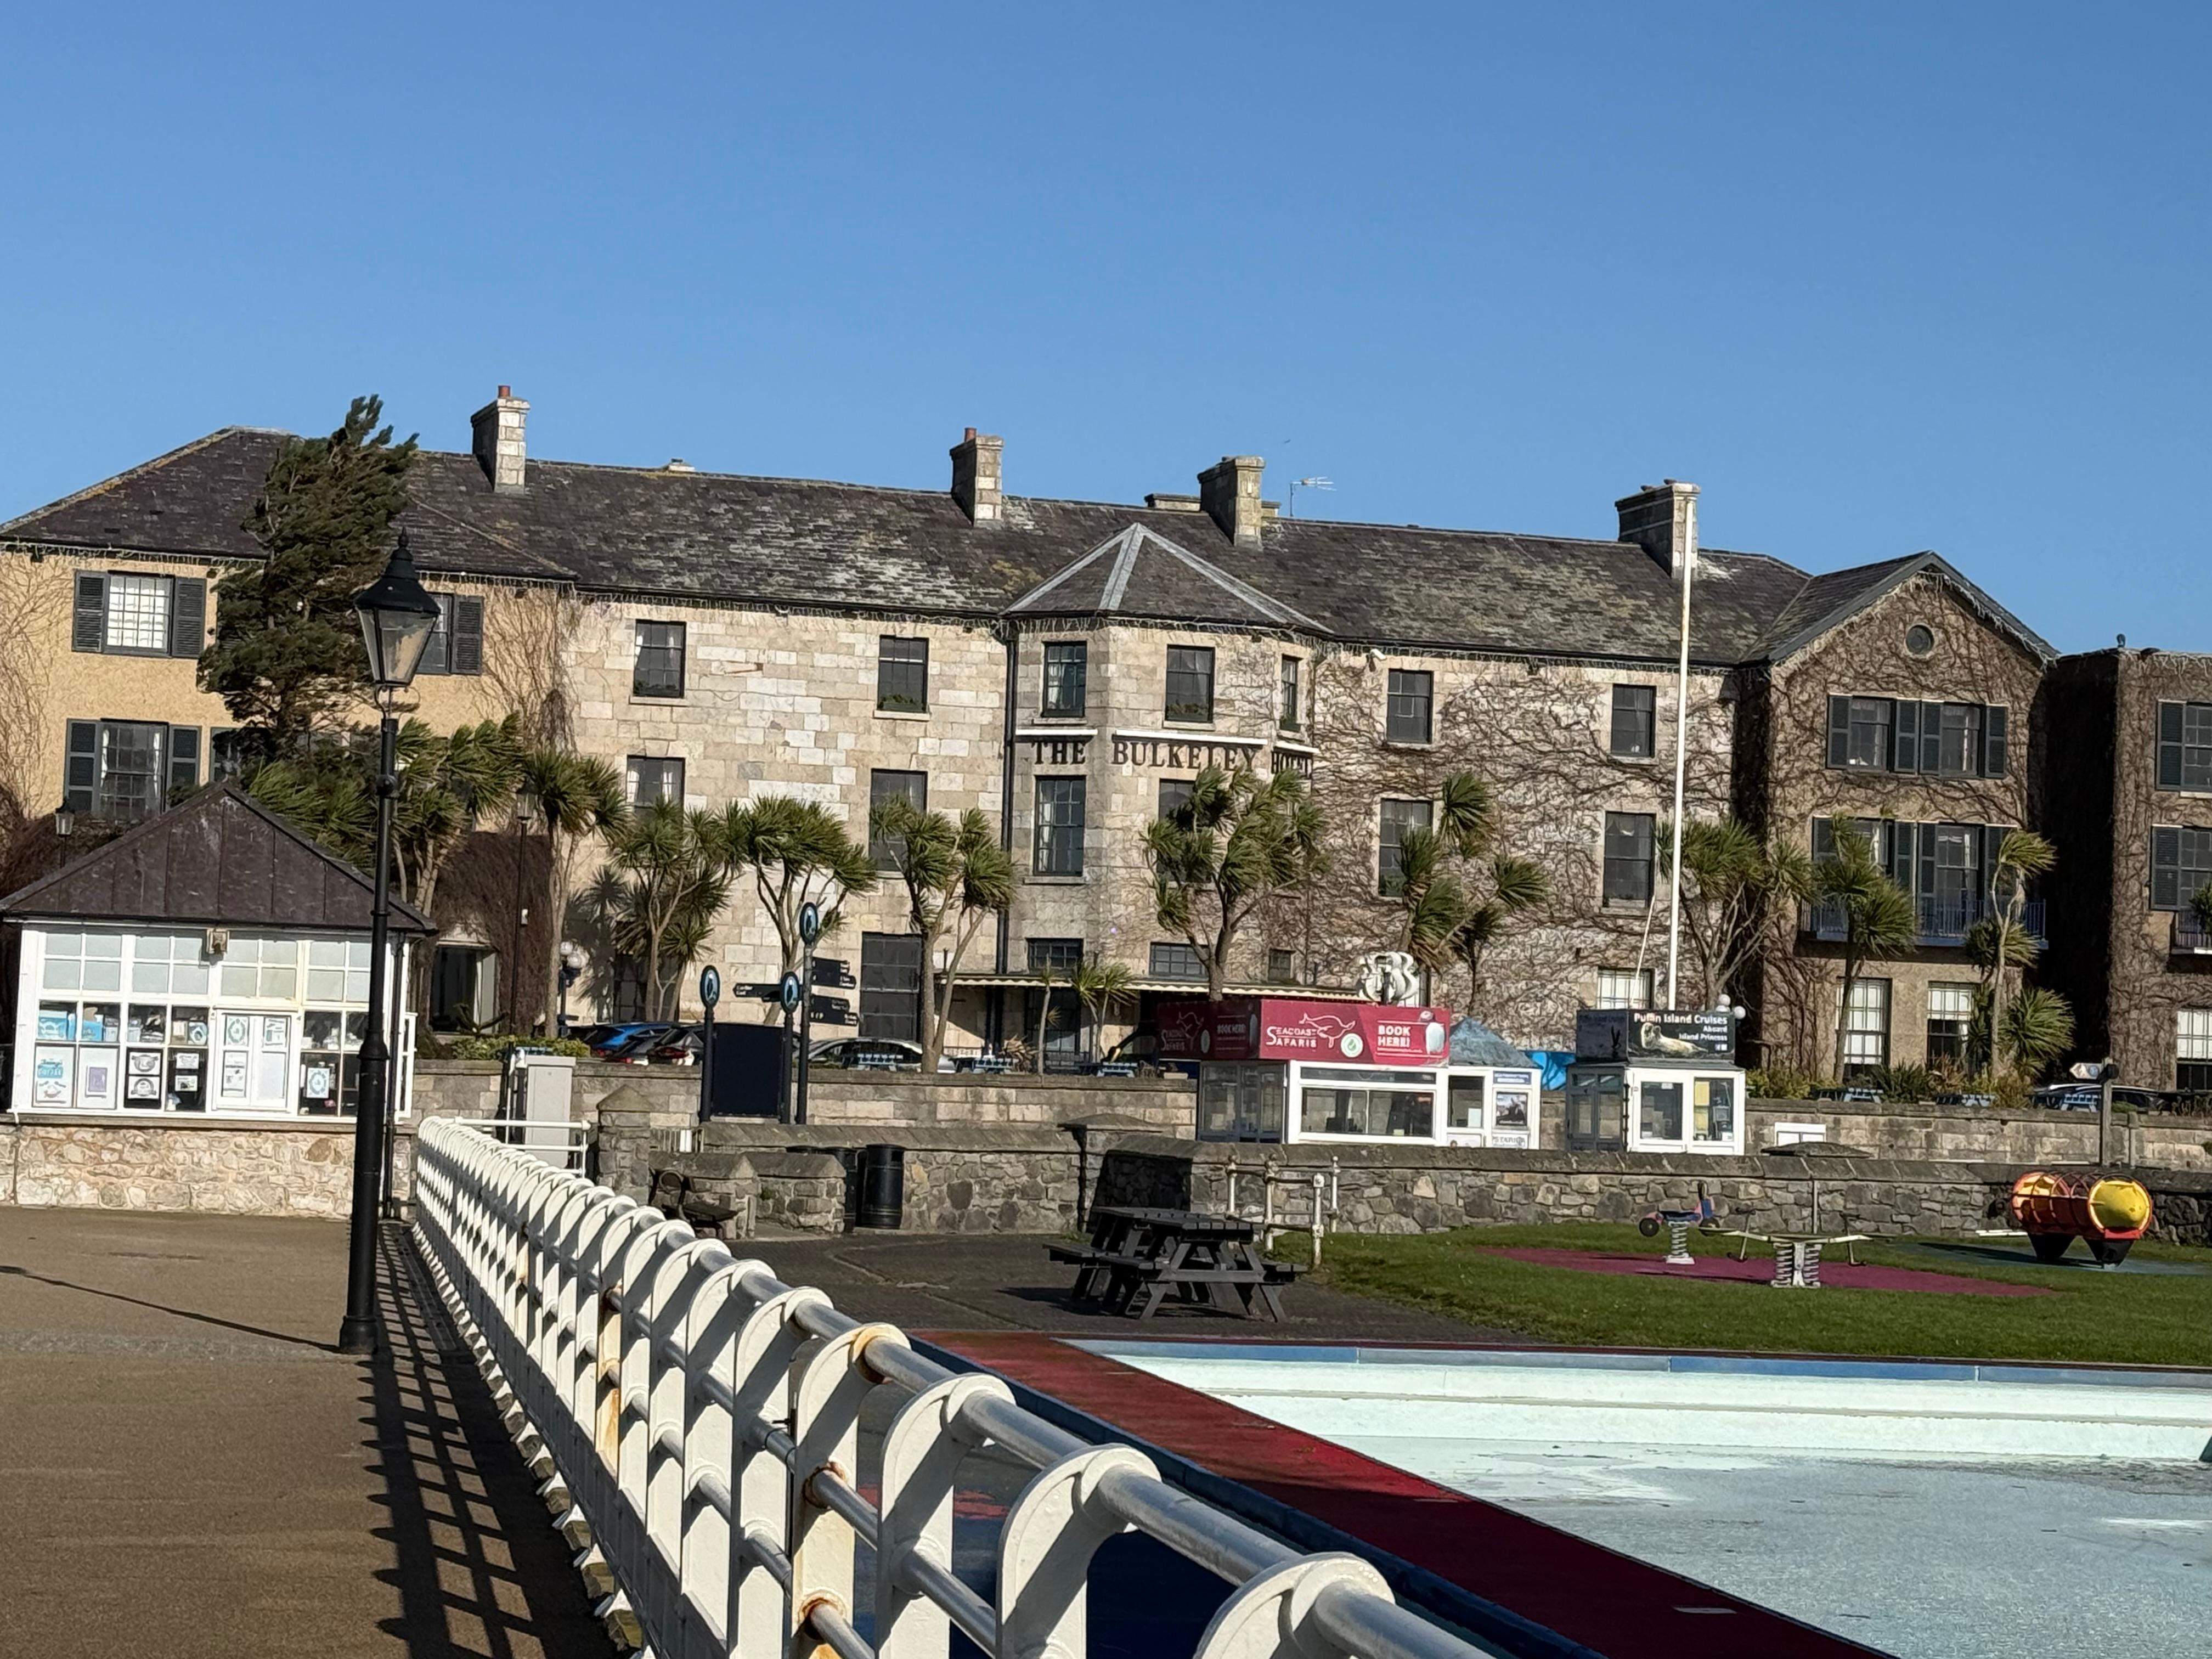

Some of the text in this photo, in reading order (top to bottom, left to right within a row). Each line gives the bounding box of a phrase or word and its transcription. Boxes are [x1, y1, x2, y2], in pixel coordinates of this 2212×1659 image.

[1031, 740, 1086, 765] THE
[1111, 741, 1256, 772] BULKELEY
[1634, 1013, 1661, 1023] Puffin
[1664, 1014, 1692, 1024] Island
[1694, 1014, 1728, 1024] Cruises
[1378, 1025, 1410, 1036] BOOK
[1266, 1036, 1317, 1048] SAFARIS
